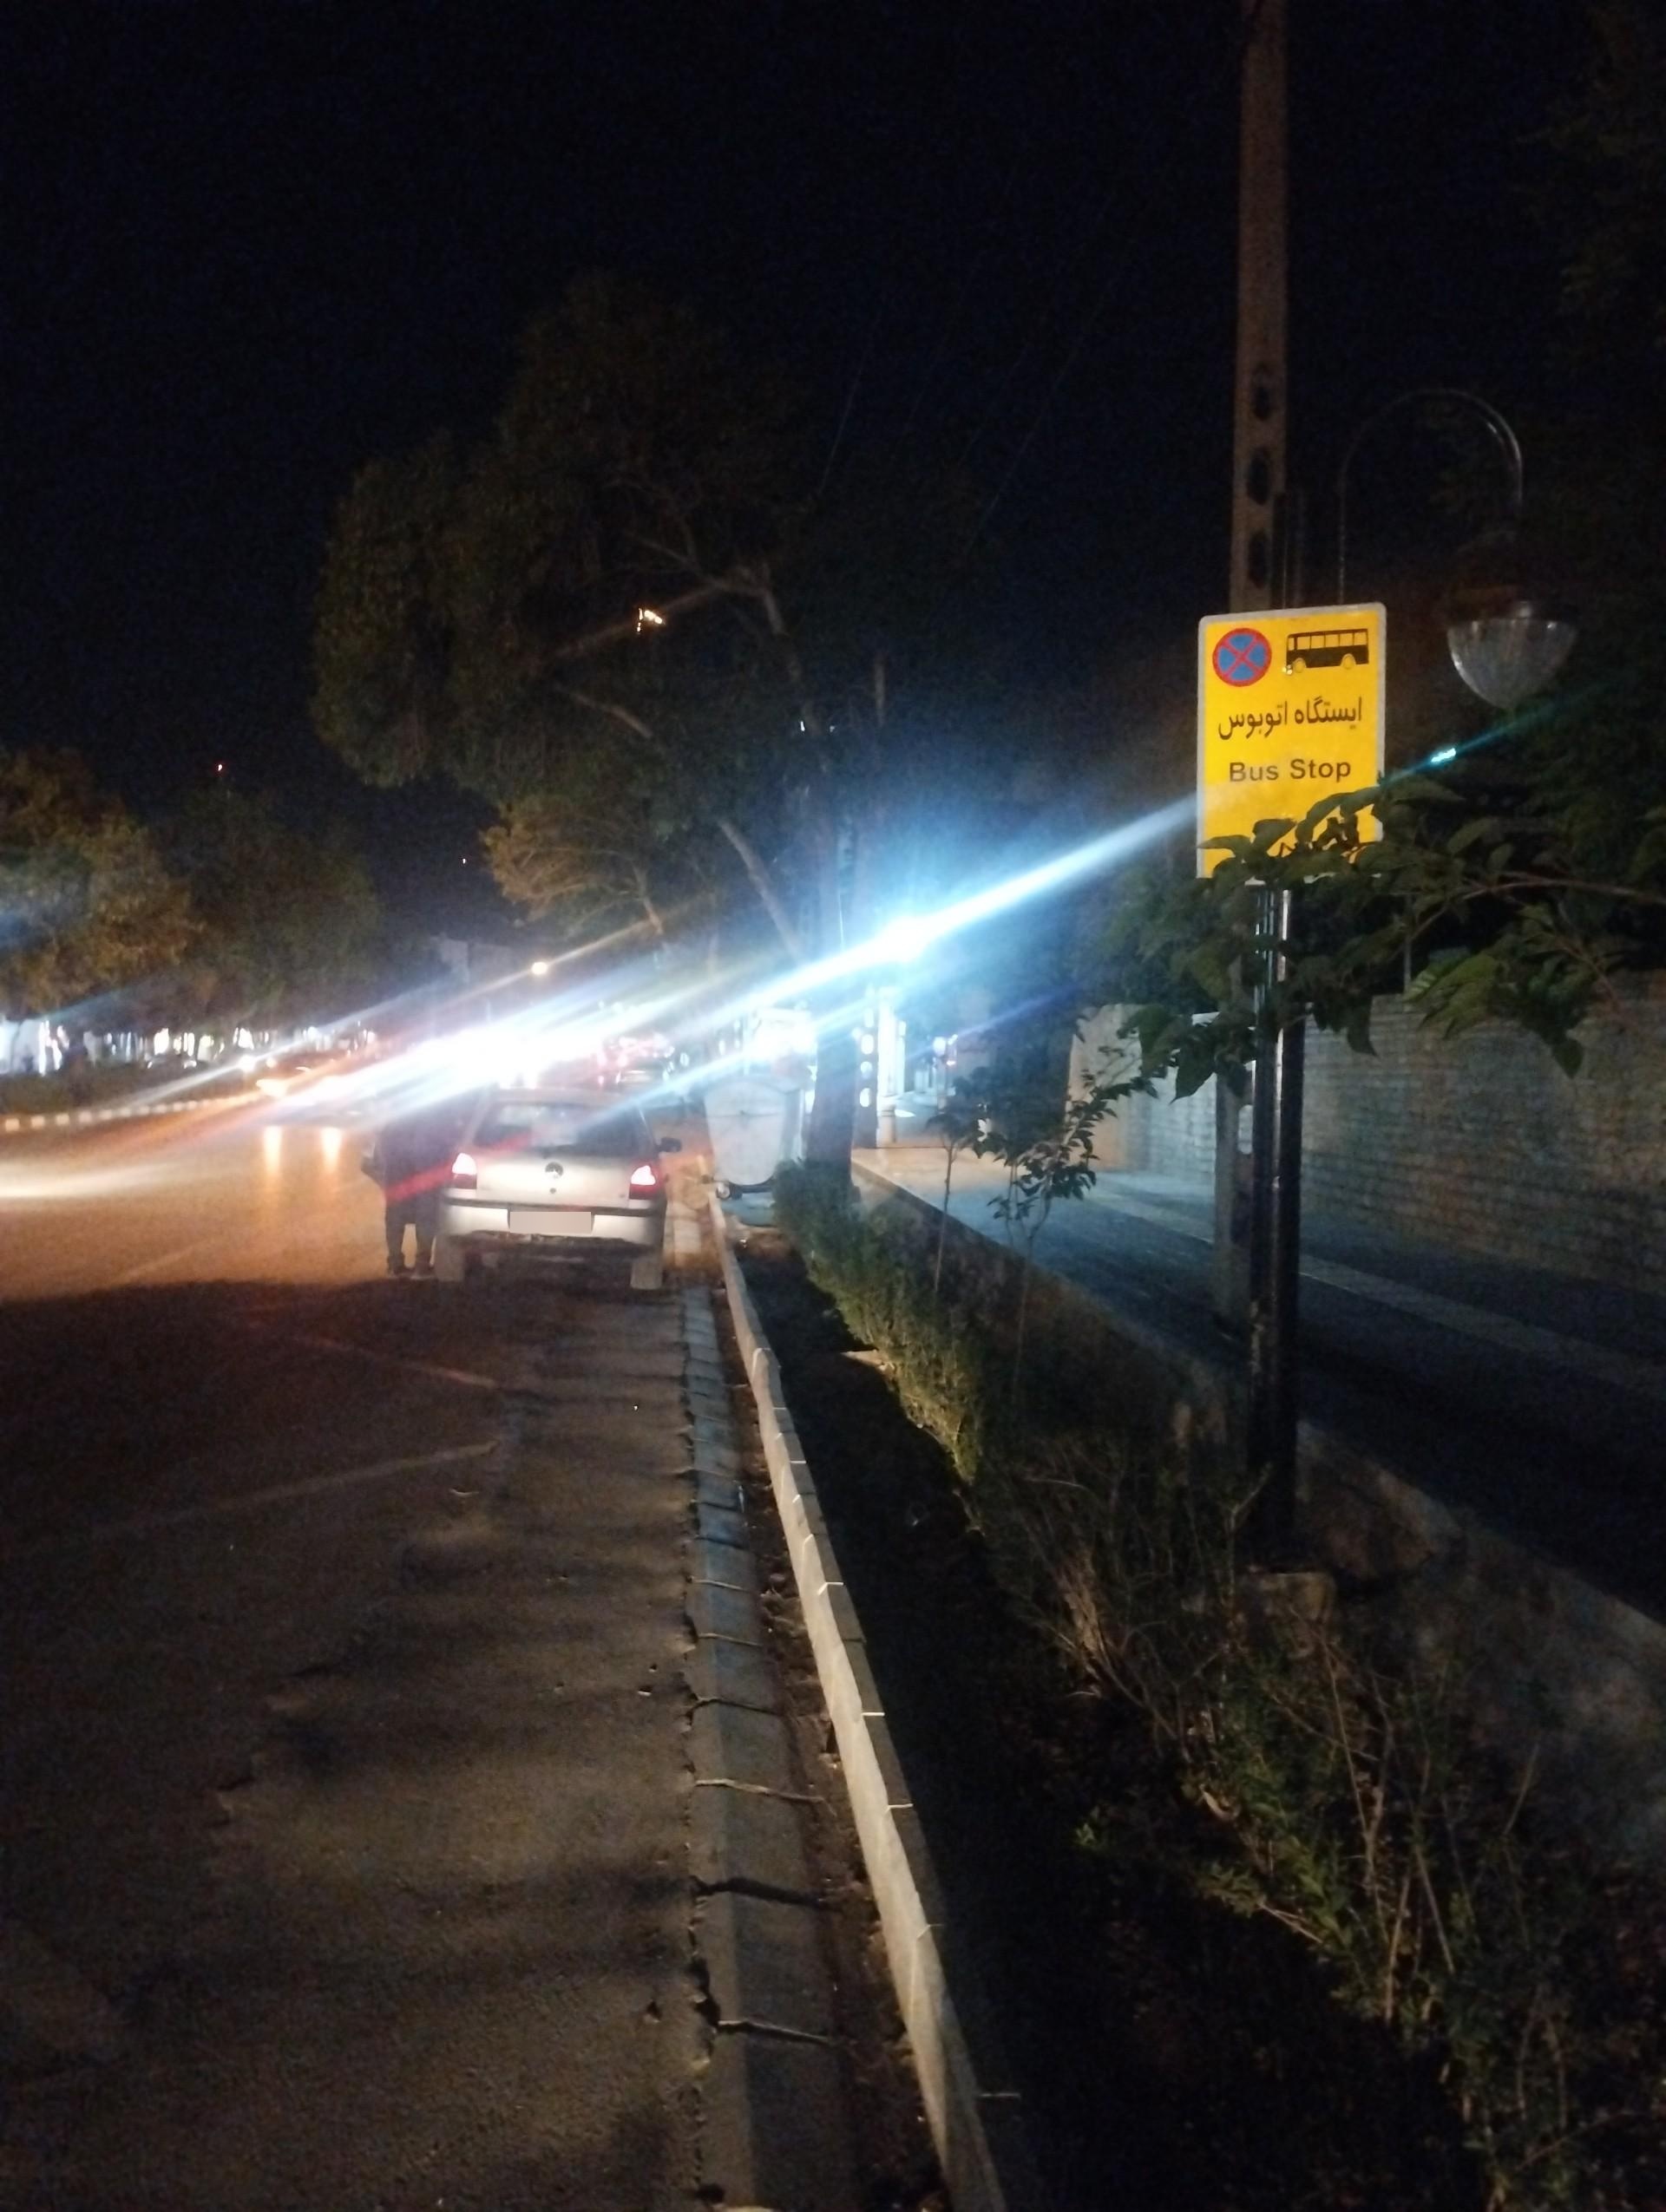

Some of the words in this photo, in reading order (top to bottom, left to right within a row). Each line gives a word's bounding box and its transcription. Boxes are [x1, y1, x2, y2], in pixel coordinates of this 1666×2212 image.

[1218, 700, 1288, 740] اتوبوس
[1294, 696, 1362, 730] ایستگاه
[1229, 762, 1279, 782] Bus
[1289, 758, 1351, 782] Stop
